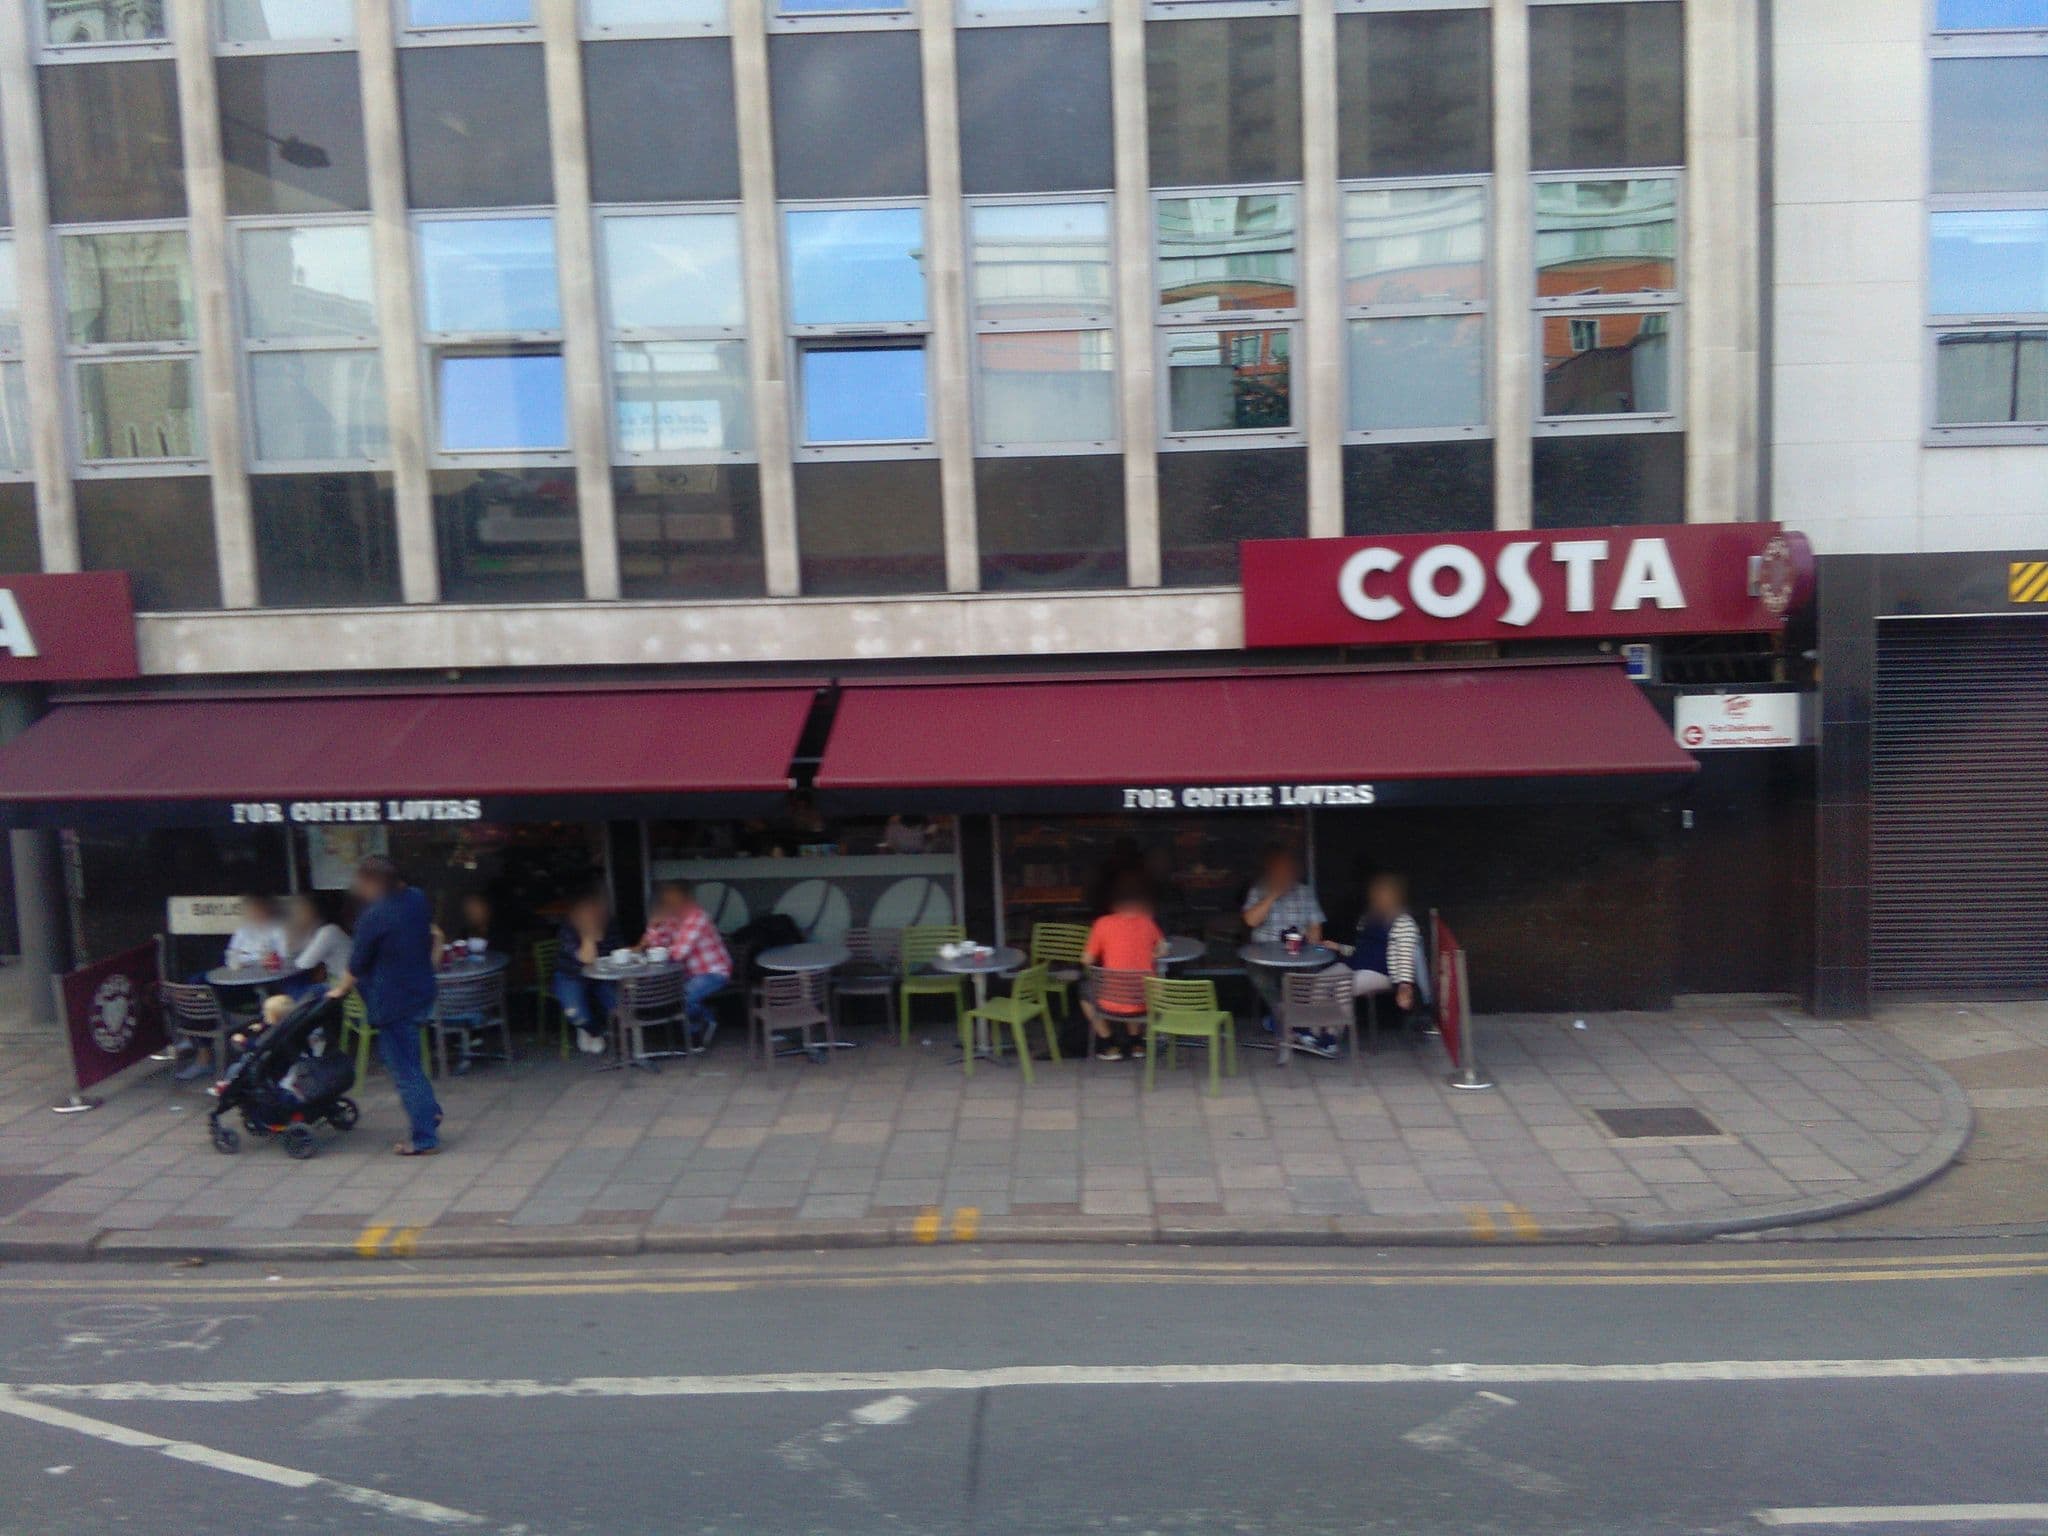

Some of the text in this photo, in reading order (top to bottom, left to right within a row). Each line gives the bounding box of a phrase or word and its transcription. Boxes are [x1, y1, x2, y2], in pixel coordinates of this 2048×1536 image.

[1337, 537, 1688, 627] COSTA
[1123, 784, 1375, 808] FOR COFFEE LOVERS
[231, 799, 482, 823] FOR COFFEE LOVERS
